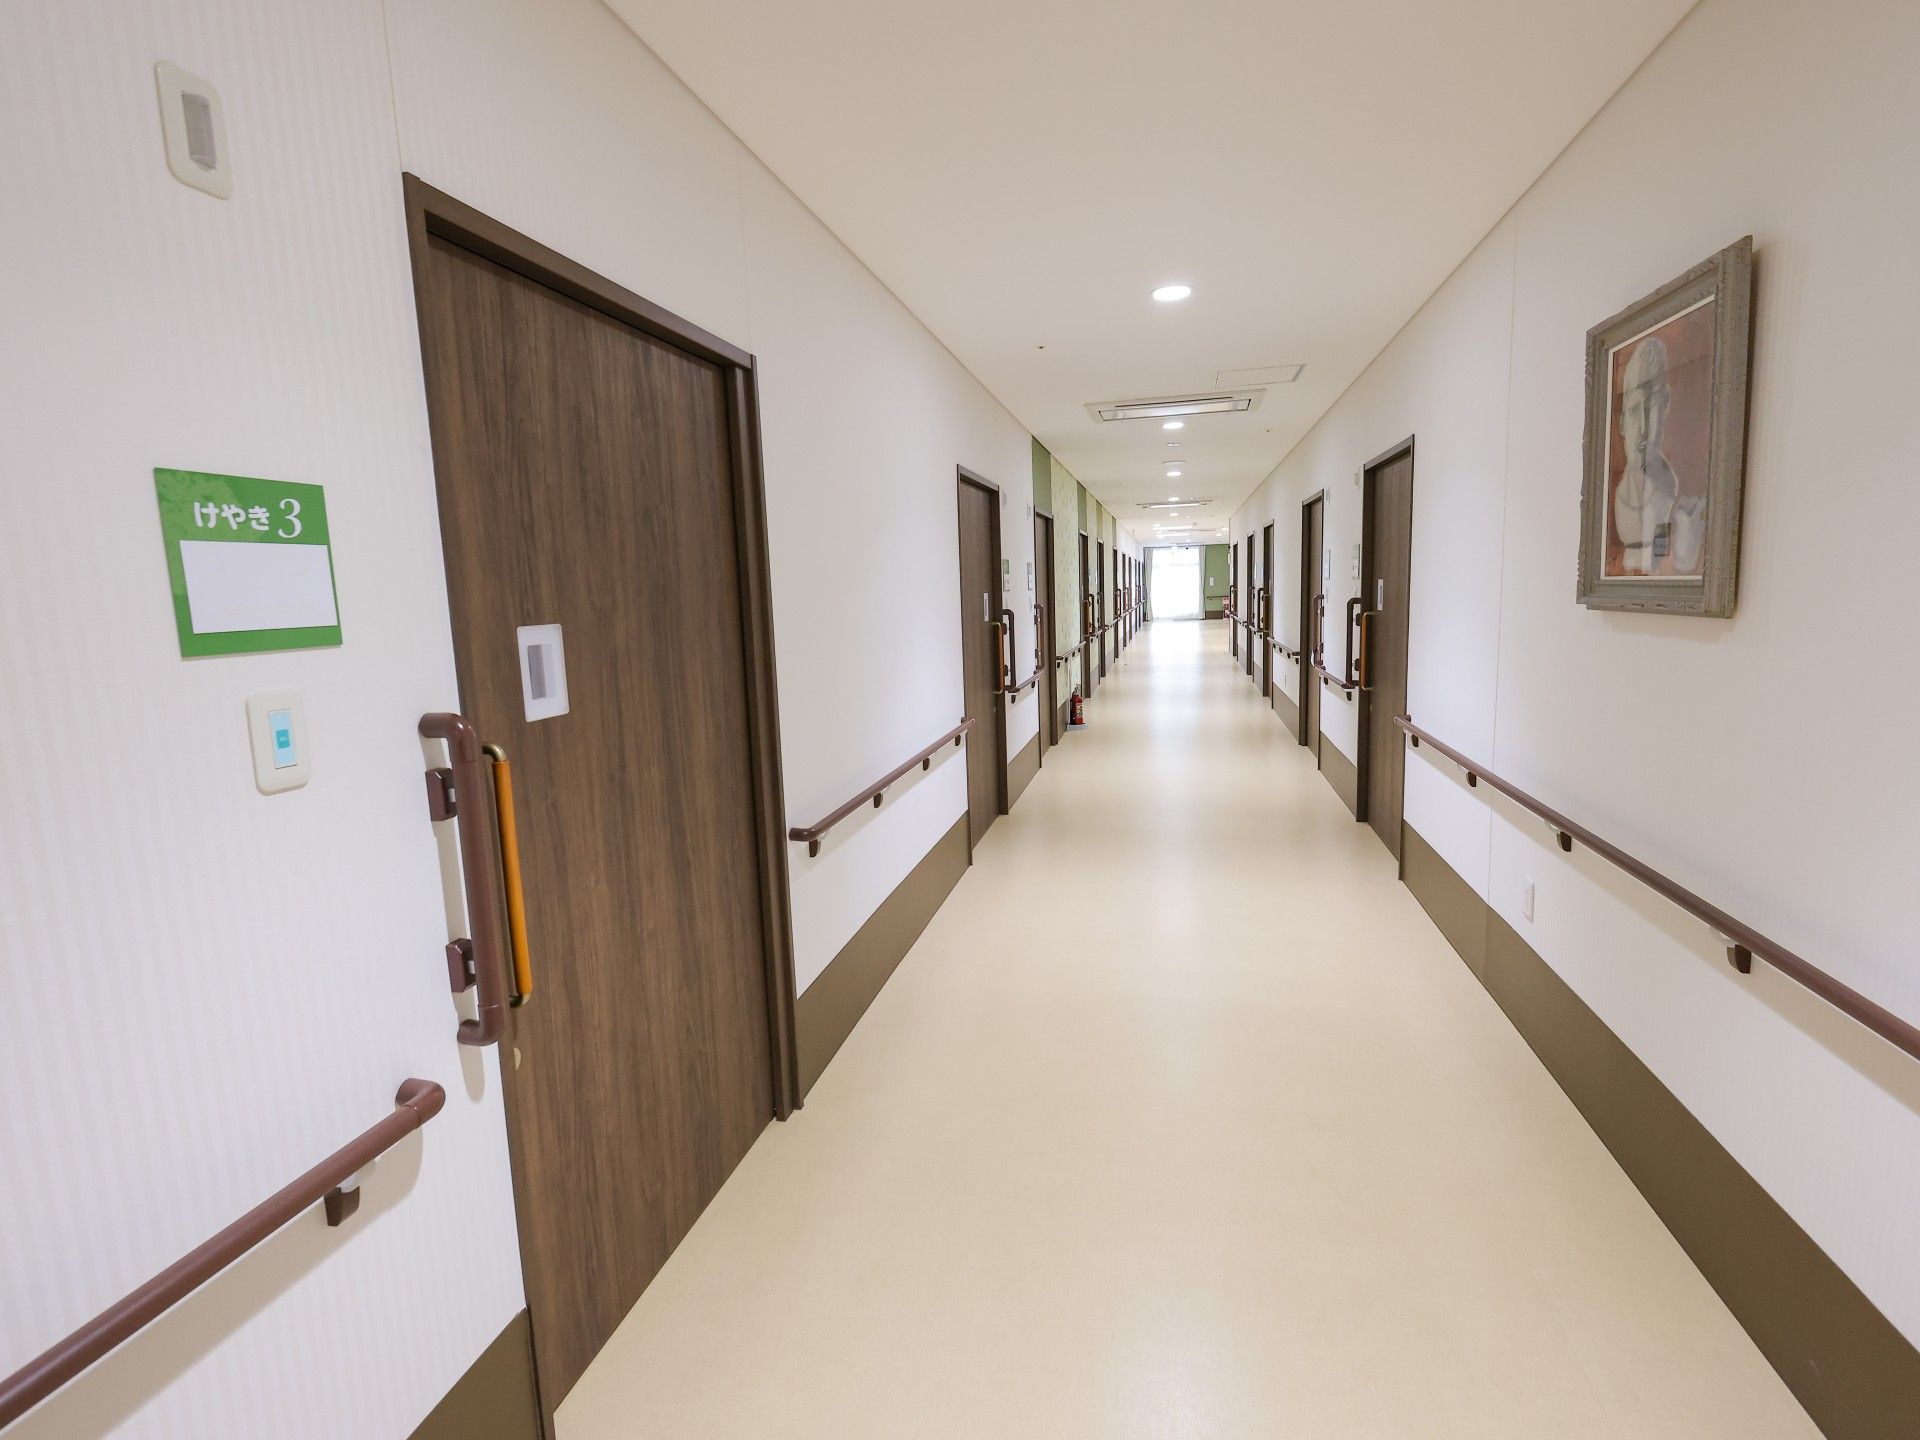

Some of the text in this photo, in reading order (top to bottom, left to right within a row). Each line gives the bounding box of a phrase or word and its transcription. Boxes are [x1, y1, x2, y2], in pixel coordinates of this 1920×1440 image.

[194, 498, 302, 538] けやき 3
